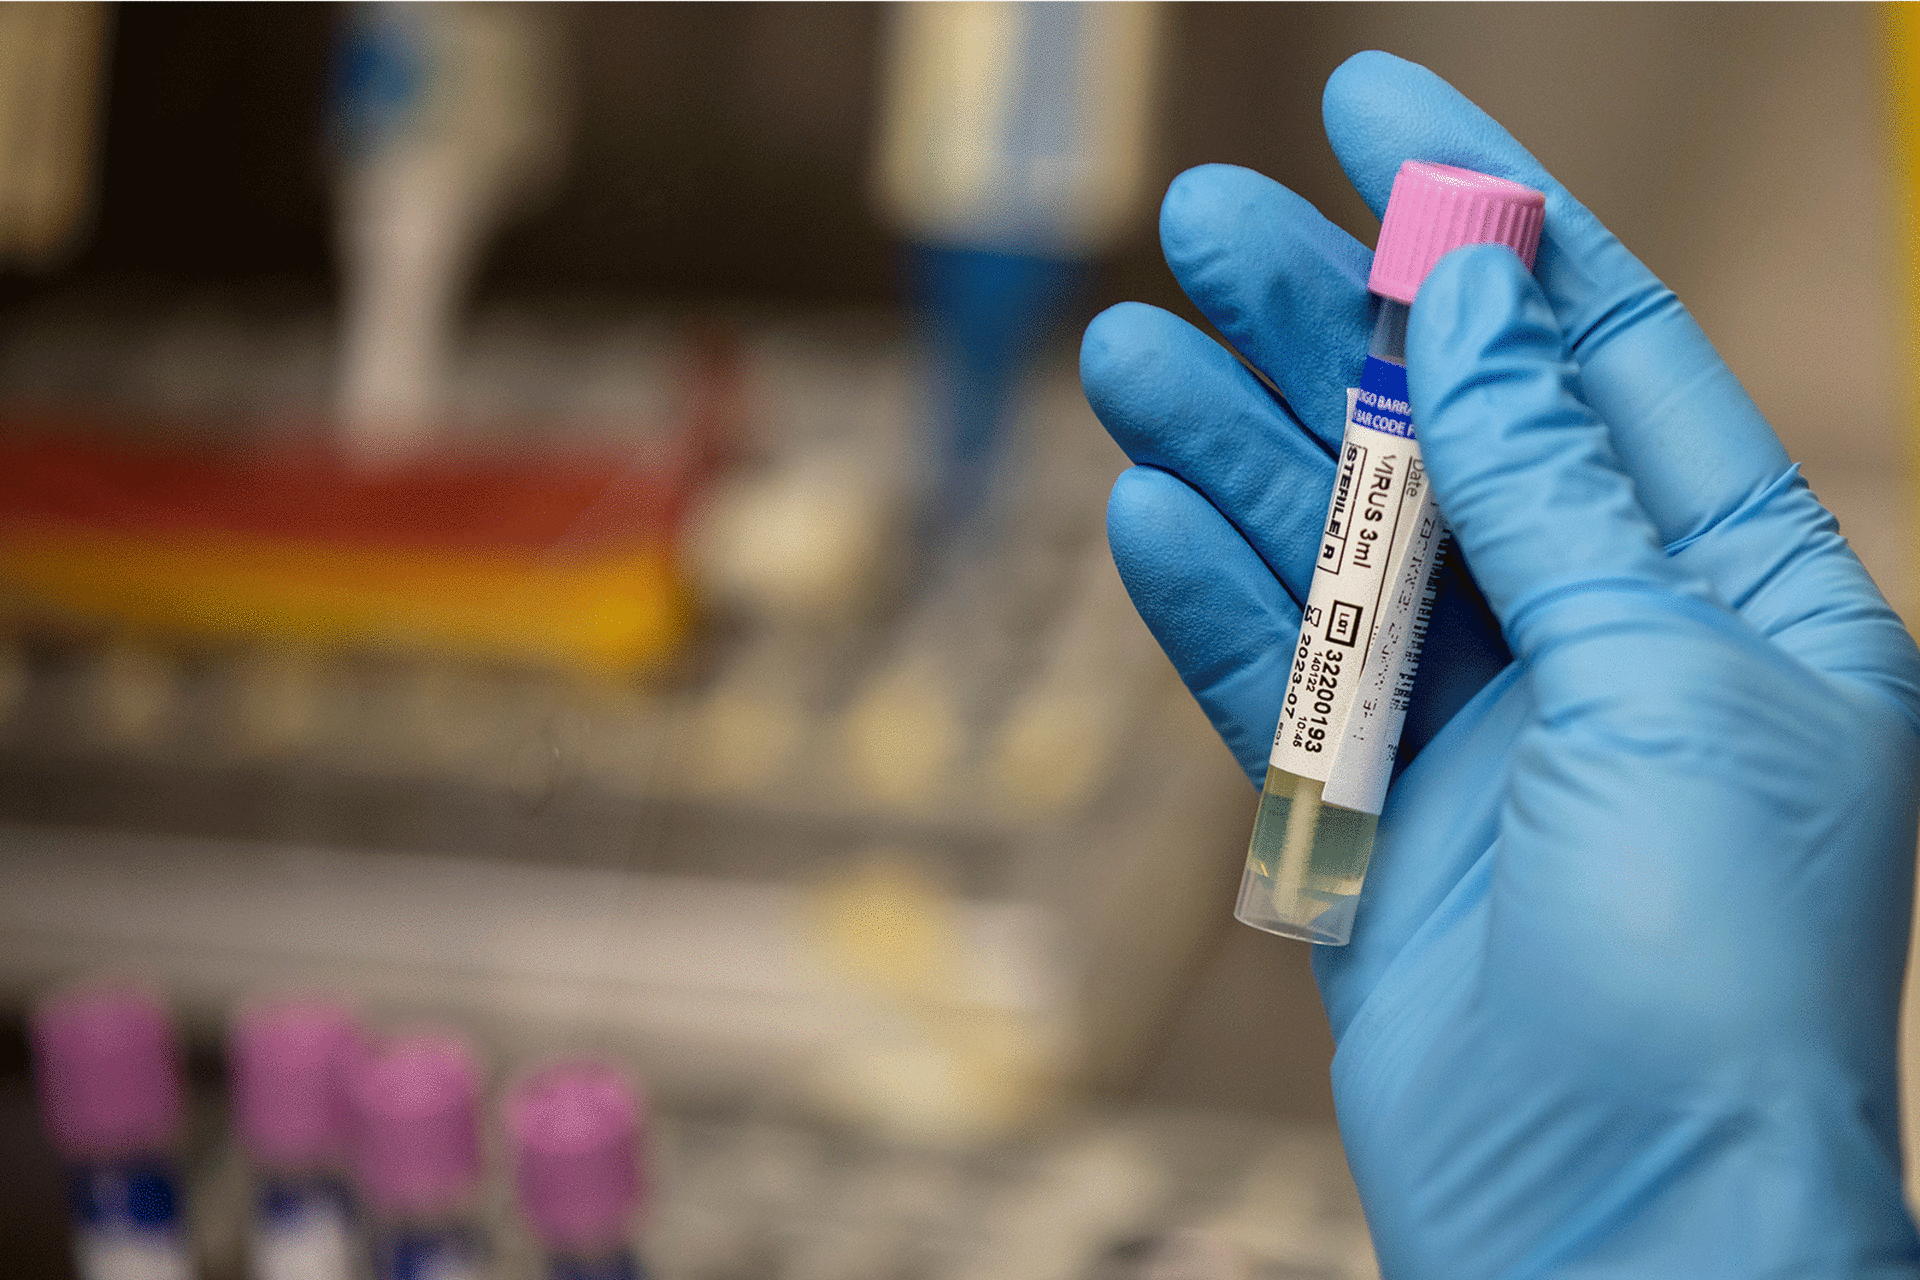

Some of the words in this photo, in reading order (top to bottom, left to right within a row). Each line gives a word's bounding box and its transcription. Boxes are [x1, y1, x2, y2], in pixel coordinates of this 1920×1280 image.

[1372, 415, 1406, 436] CODE
[1329, 445, 1357, 535] STERILE
[1364, 454, 1396, 522] VIRUS
[1406, 459, 1425, 498] Date
[1323, 544, 1336, 560] R
[1353, 528, 1378, 569] 3ml
[1336, 612, 1350, 636] LOT
[1285, 632, 1312, 719] 2023-07
[1305, 651, 1323, 693] 140122
[1304, 649, 1343, 753] 32200193
